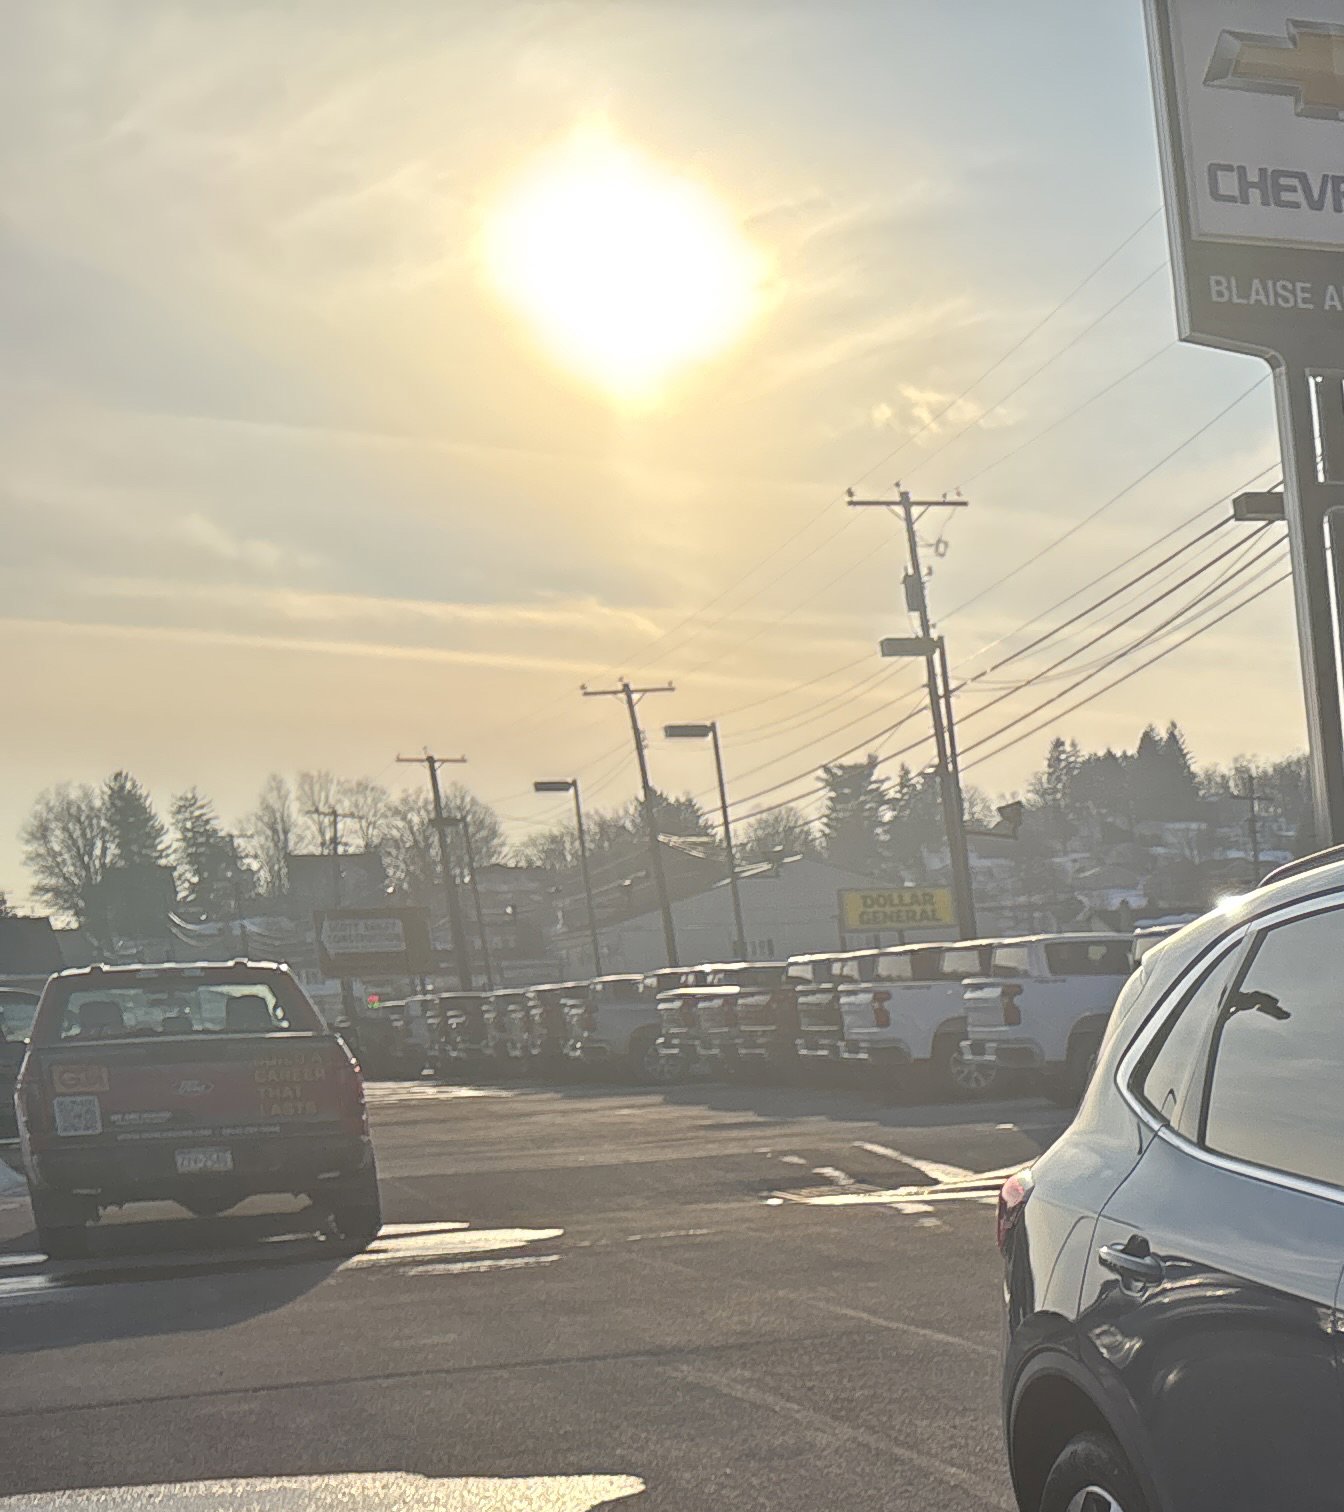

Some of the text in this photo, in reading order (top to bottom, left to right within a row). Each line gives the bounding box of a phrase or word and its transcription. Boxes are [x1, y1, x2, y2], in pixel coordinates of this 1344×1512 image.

[1209, 274, 1314, 311] BLAISE
[860, 892, 935, 908] DOLLAR
[859, 908, 943, 925] GENERAL
